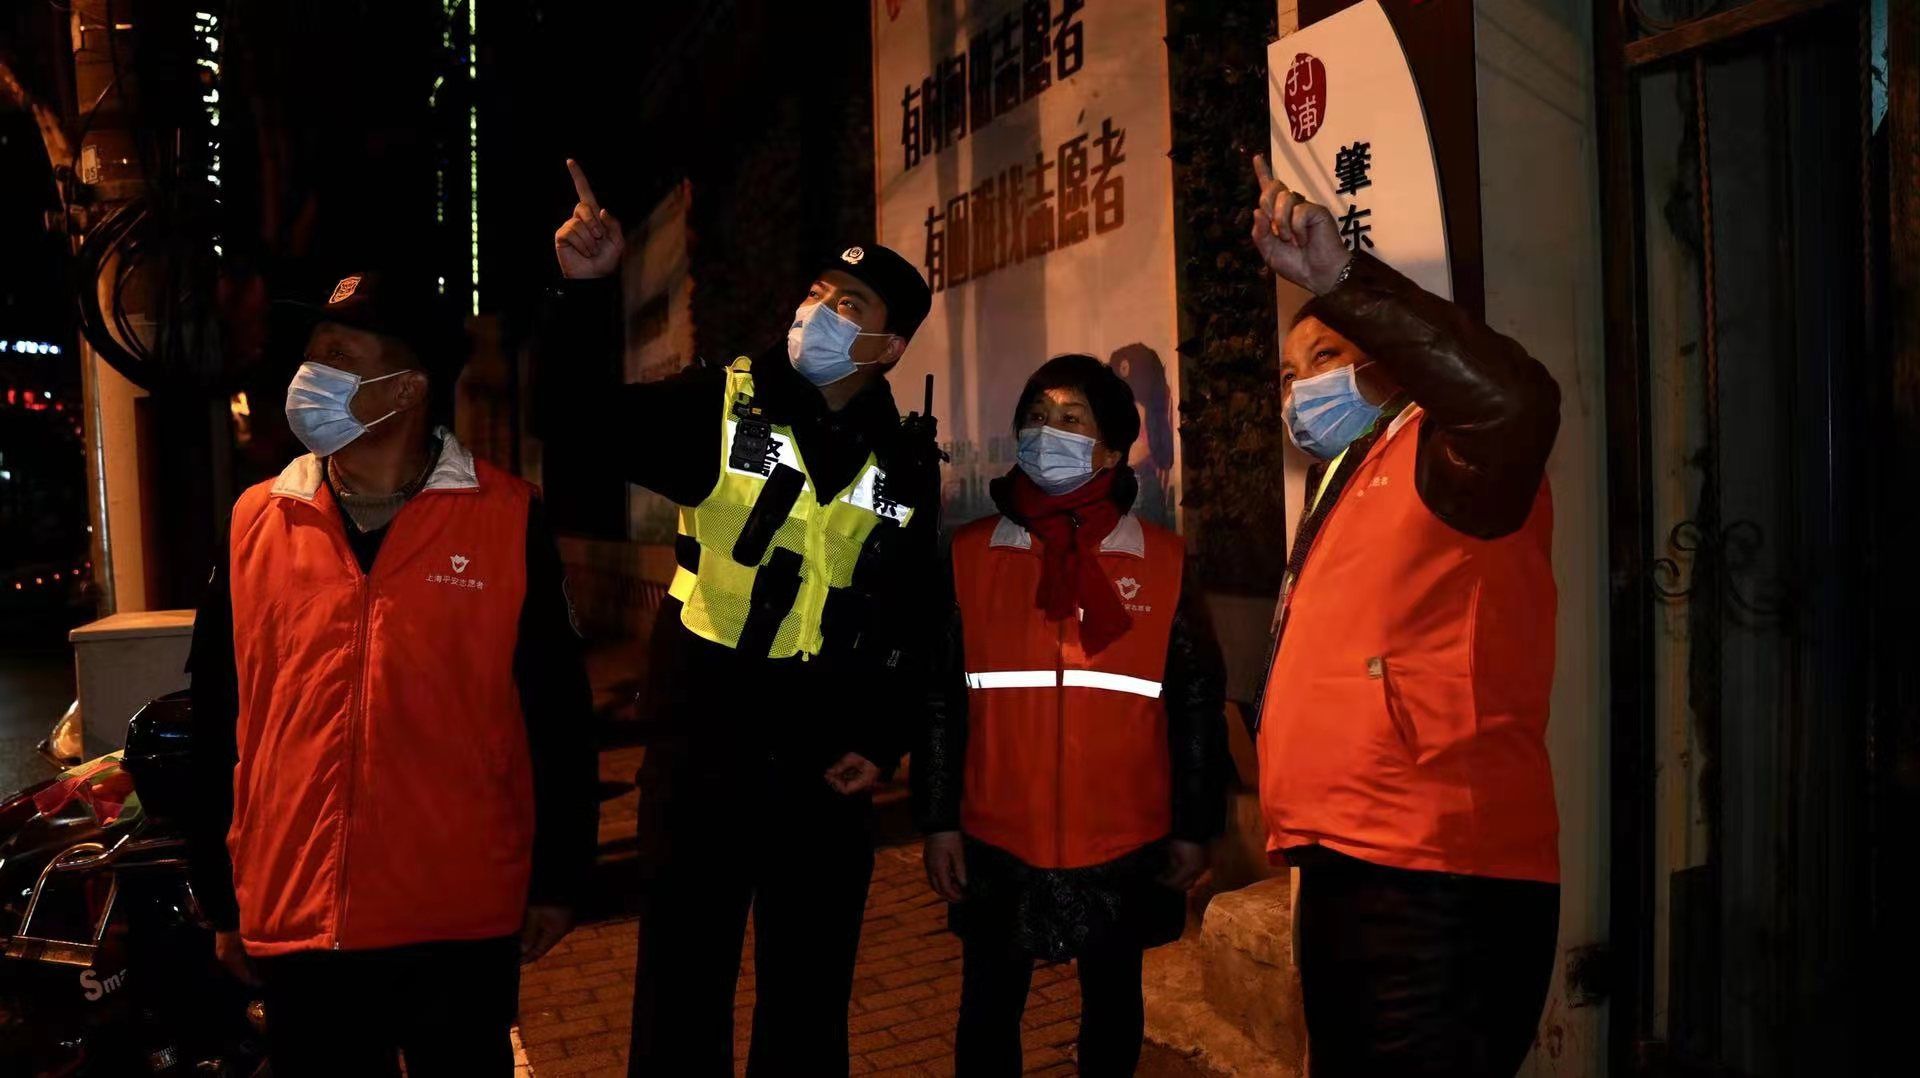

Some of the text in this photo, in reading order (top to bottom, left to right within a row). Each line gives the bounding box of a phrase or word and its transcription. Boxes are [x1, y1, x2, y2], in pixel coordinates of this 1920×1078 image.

[1287, 56, 1319, 140] 打浦
[925, 109, 1126, 294] 有困难找志愿者
[1335, 142, 1375, 251] 肇东
